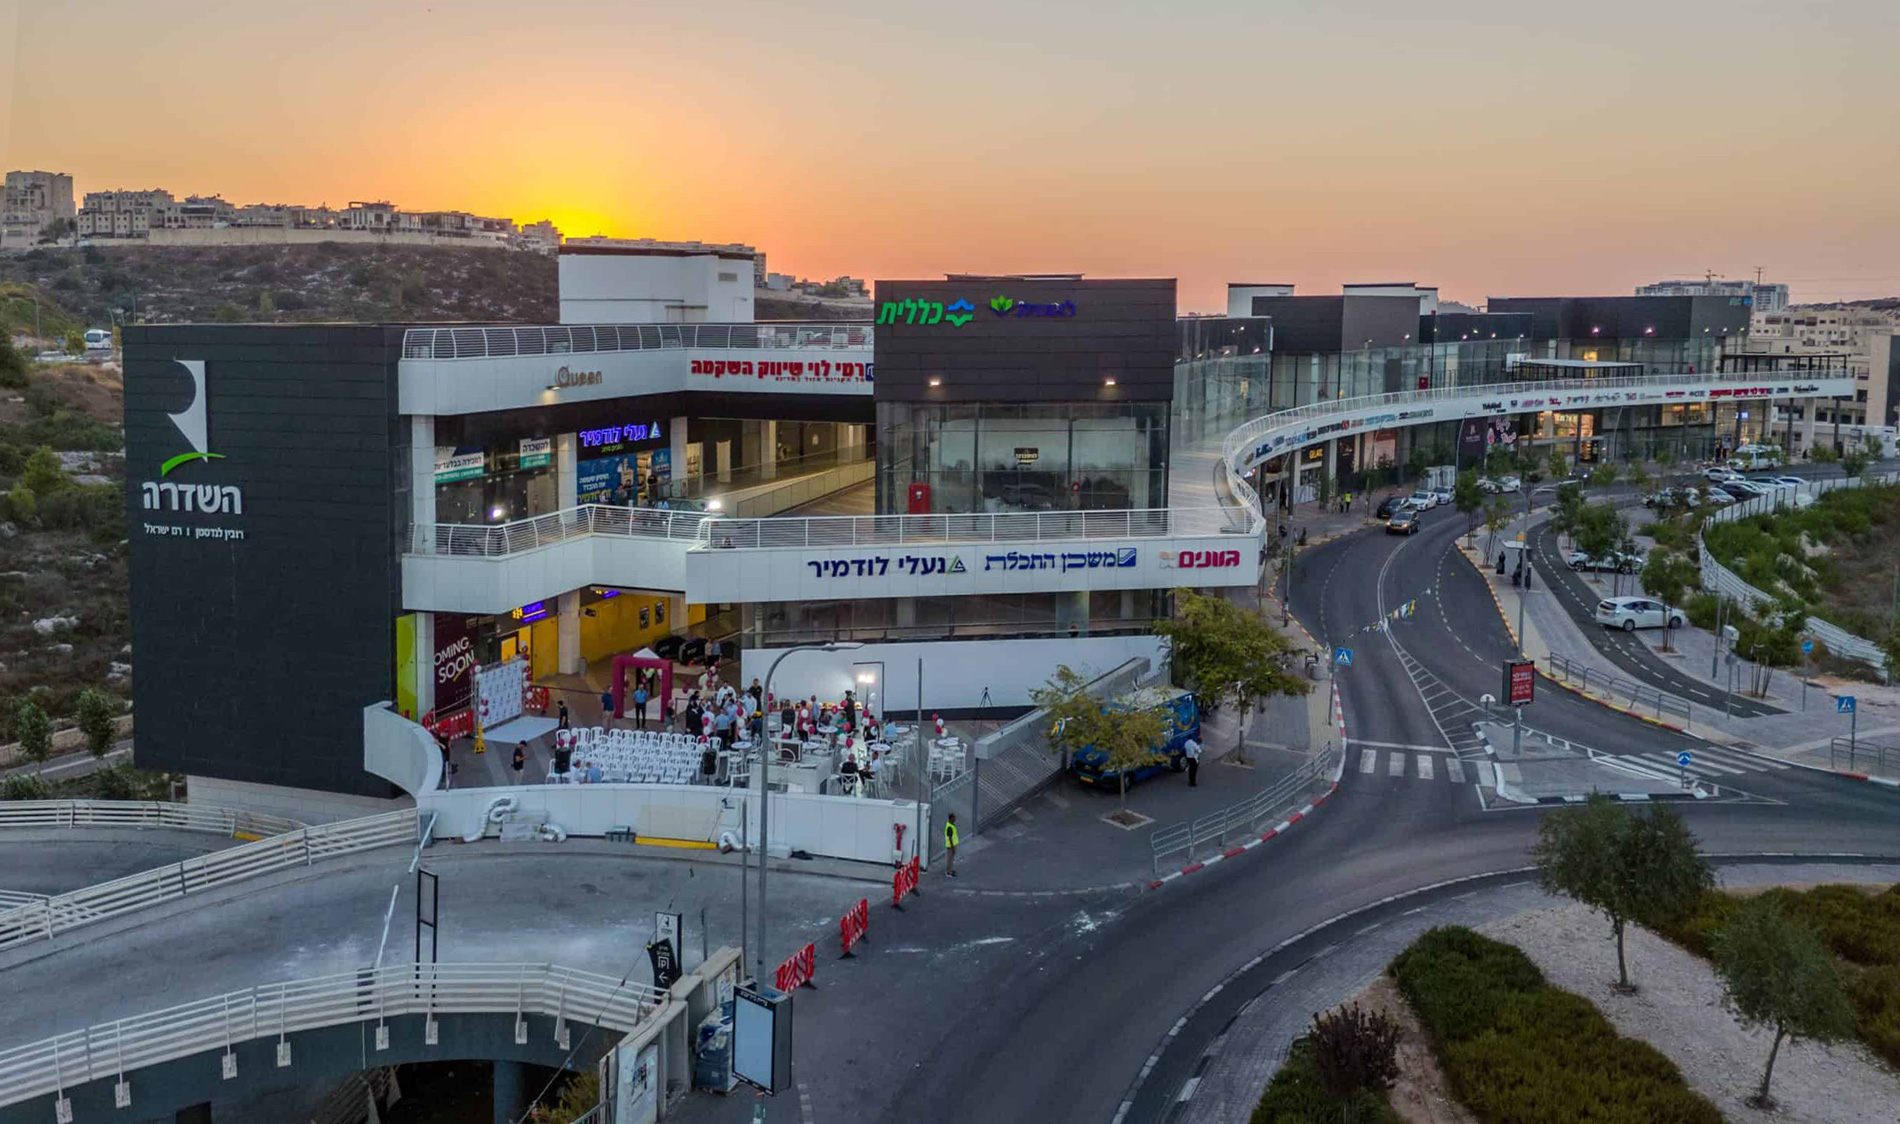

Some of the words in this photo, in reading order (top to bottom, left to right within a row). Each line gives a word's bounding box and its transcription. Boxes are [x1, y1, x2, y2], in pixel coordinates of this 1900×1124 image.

[876, 298, 944, 325] כללית
[555, 365, 603, 387] Queen
[691, 360, 754, 379] השקמה
[757, 361, 804, 379] שיווק
[808, 360, 831, 377] לוי
[835, 362, 865, 377] רמי
[579, 427, 622, 447] לודמיר
[624, 424, 648, 441] נעלי
[522, 441, 550, 452] להשכרה
[462, 456, 482, 467] למכירה
[142, 481, 242, 515] השדרה
[143, 523, 169, 535] ישראל
[171, 527, 182, 535] רם
[195, 528, 223, 539] לנדסמן
[808, 555, 890, 578] לודמיר
[899, 555, 946, 575] נעלי
[985, 551, 1055, 570] התכלת
[1062, 552, 1116, 573] משכן
[1179, 550, 1240, 568] גוונים
[434, 637, 470, 666] OMING
[439, 650, 475, 684] SOON
